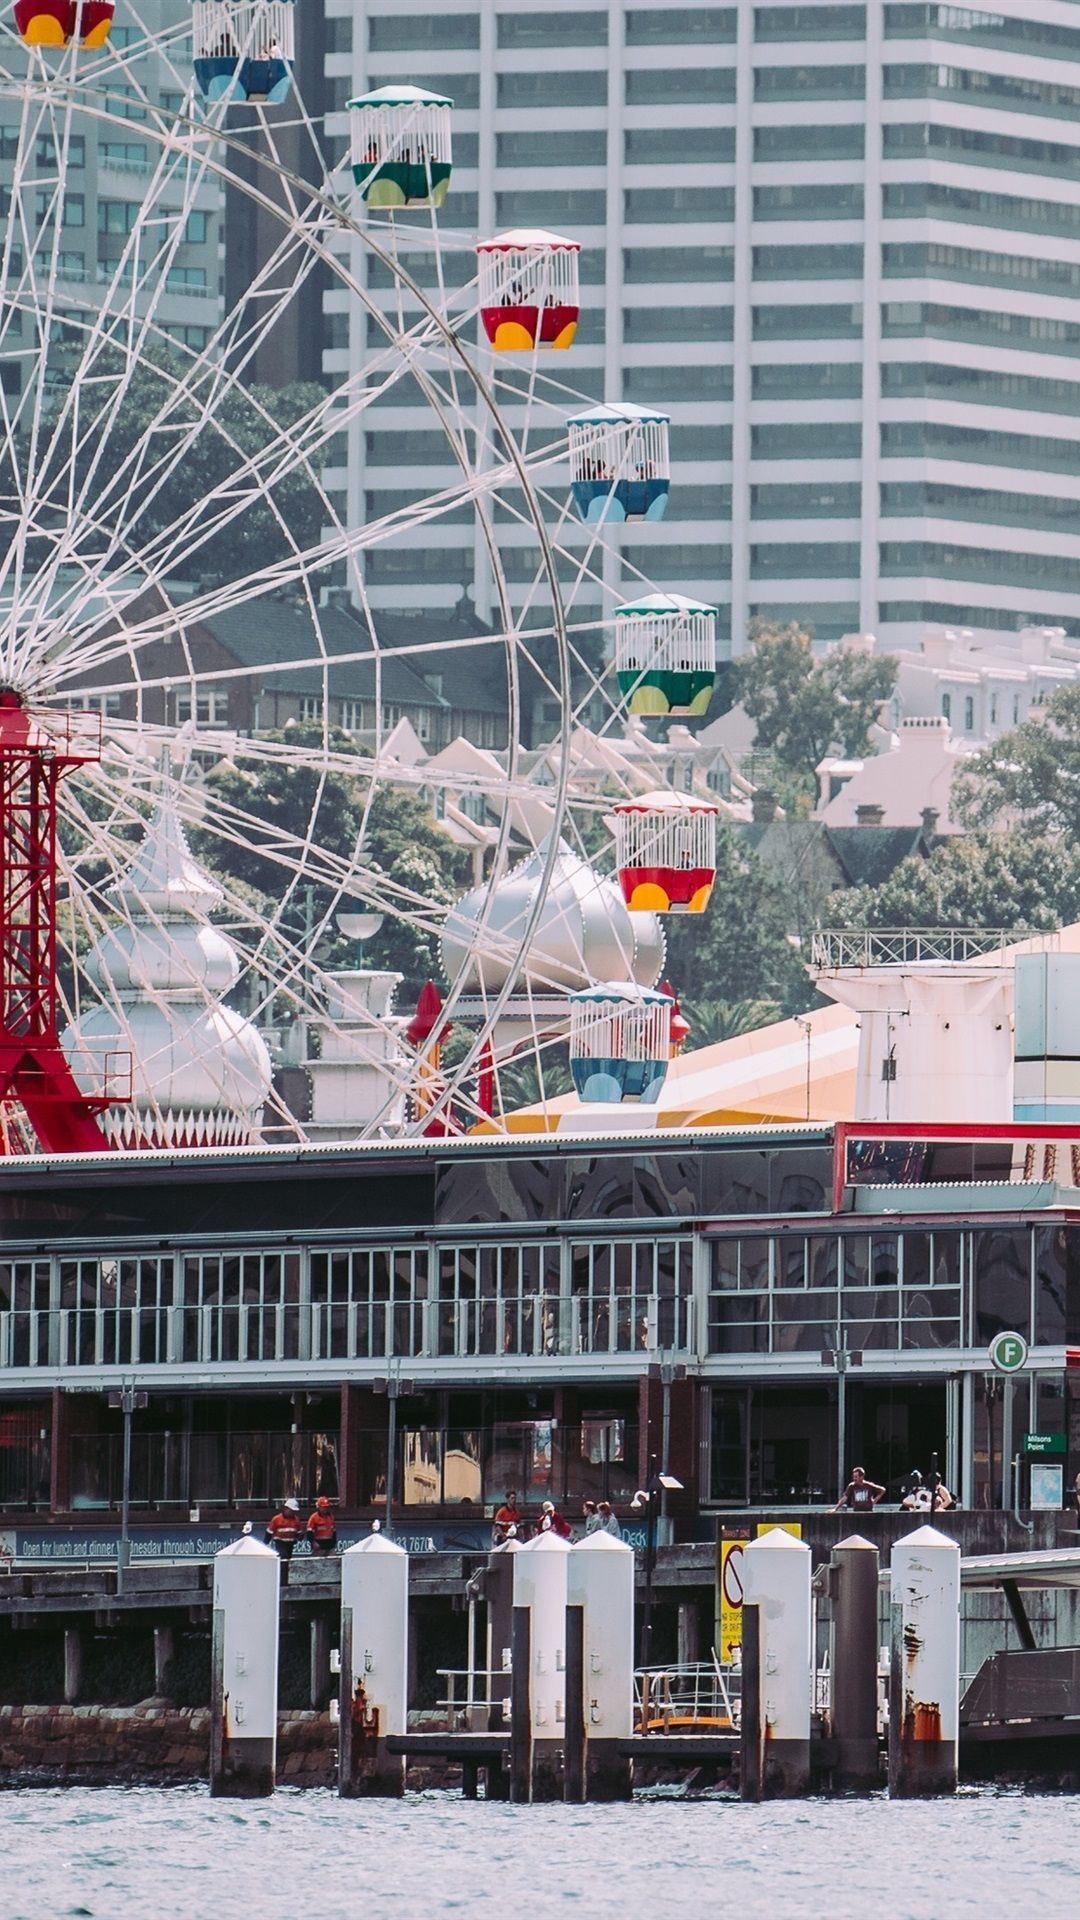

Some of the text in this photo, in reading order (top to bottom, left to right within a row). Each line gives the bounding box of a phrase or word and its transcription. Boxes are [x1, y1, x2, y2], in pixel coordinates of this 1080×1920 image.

[1004, 1343, 1016, 1363] F
[1027, 1435, 1052, 1443] Milsons
[1027, 1443, 1045, 1451] Point
[23, 1541, 40, 1556] Open
[42, 1541, 52, 1555] for
[53, 1541, 73, 1555] lunch
[74, 1541, 87, 1555] and
[89, 1540, 115, 1555] dinner
[163, 1539, 195, 1555] through
